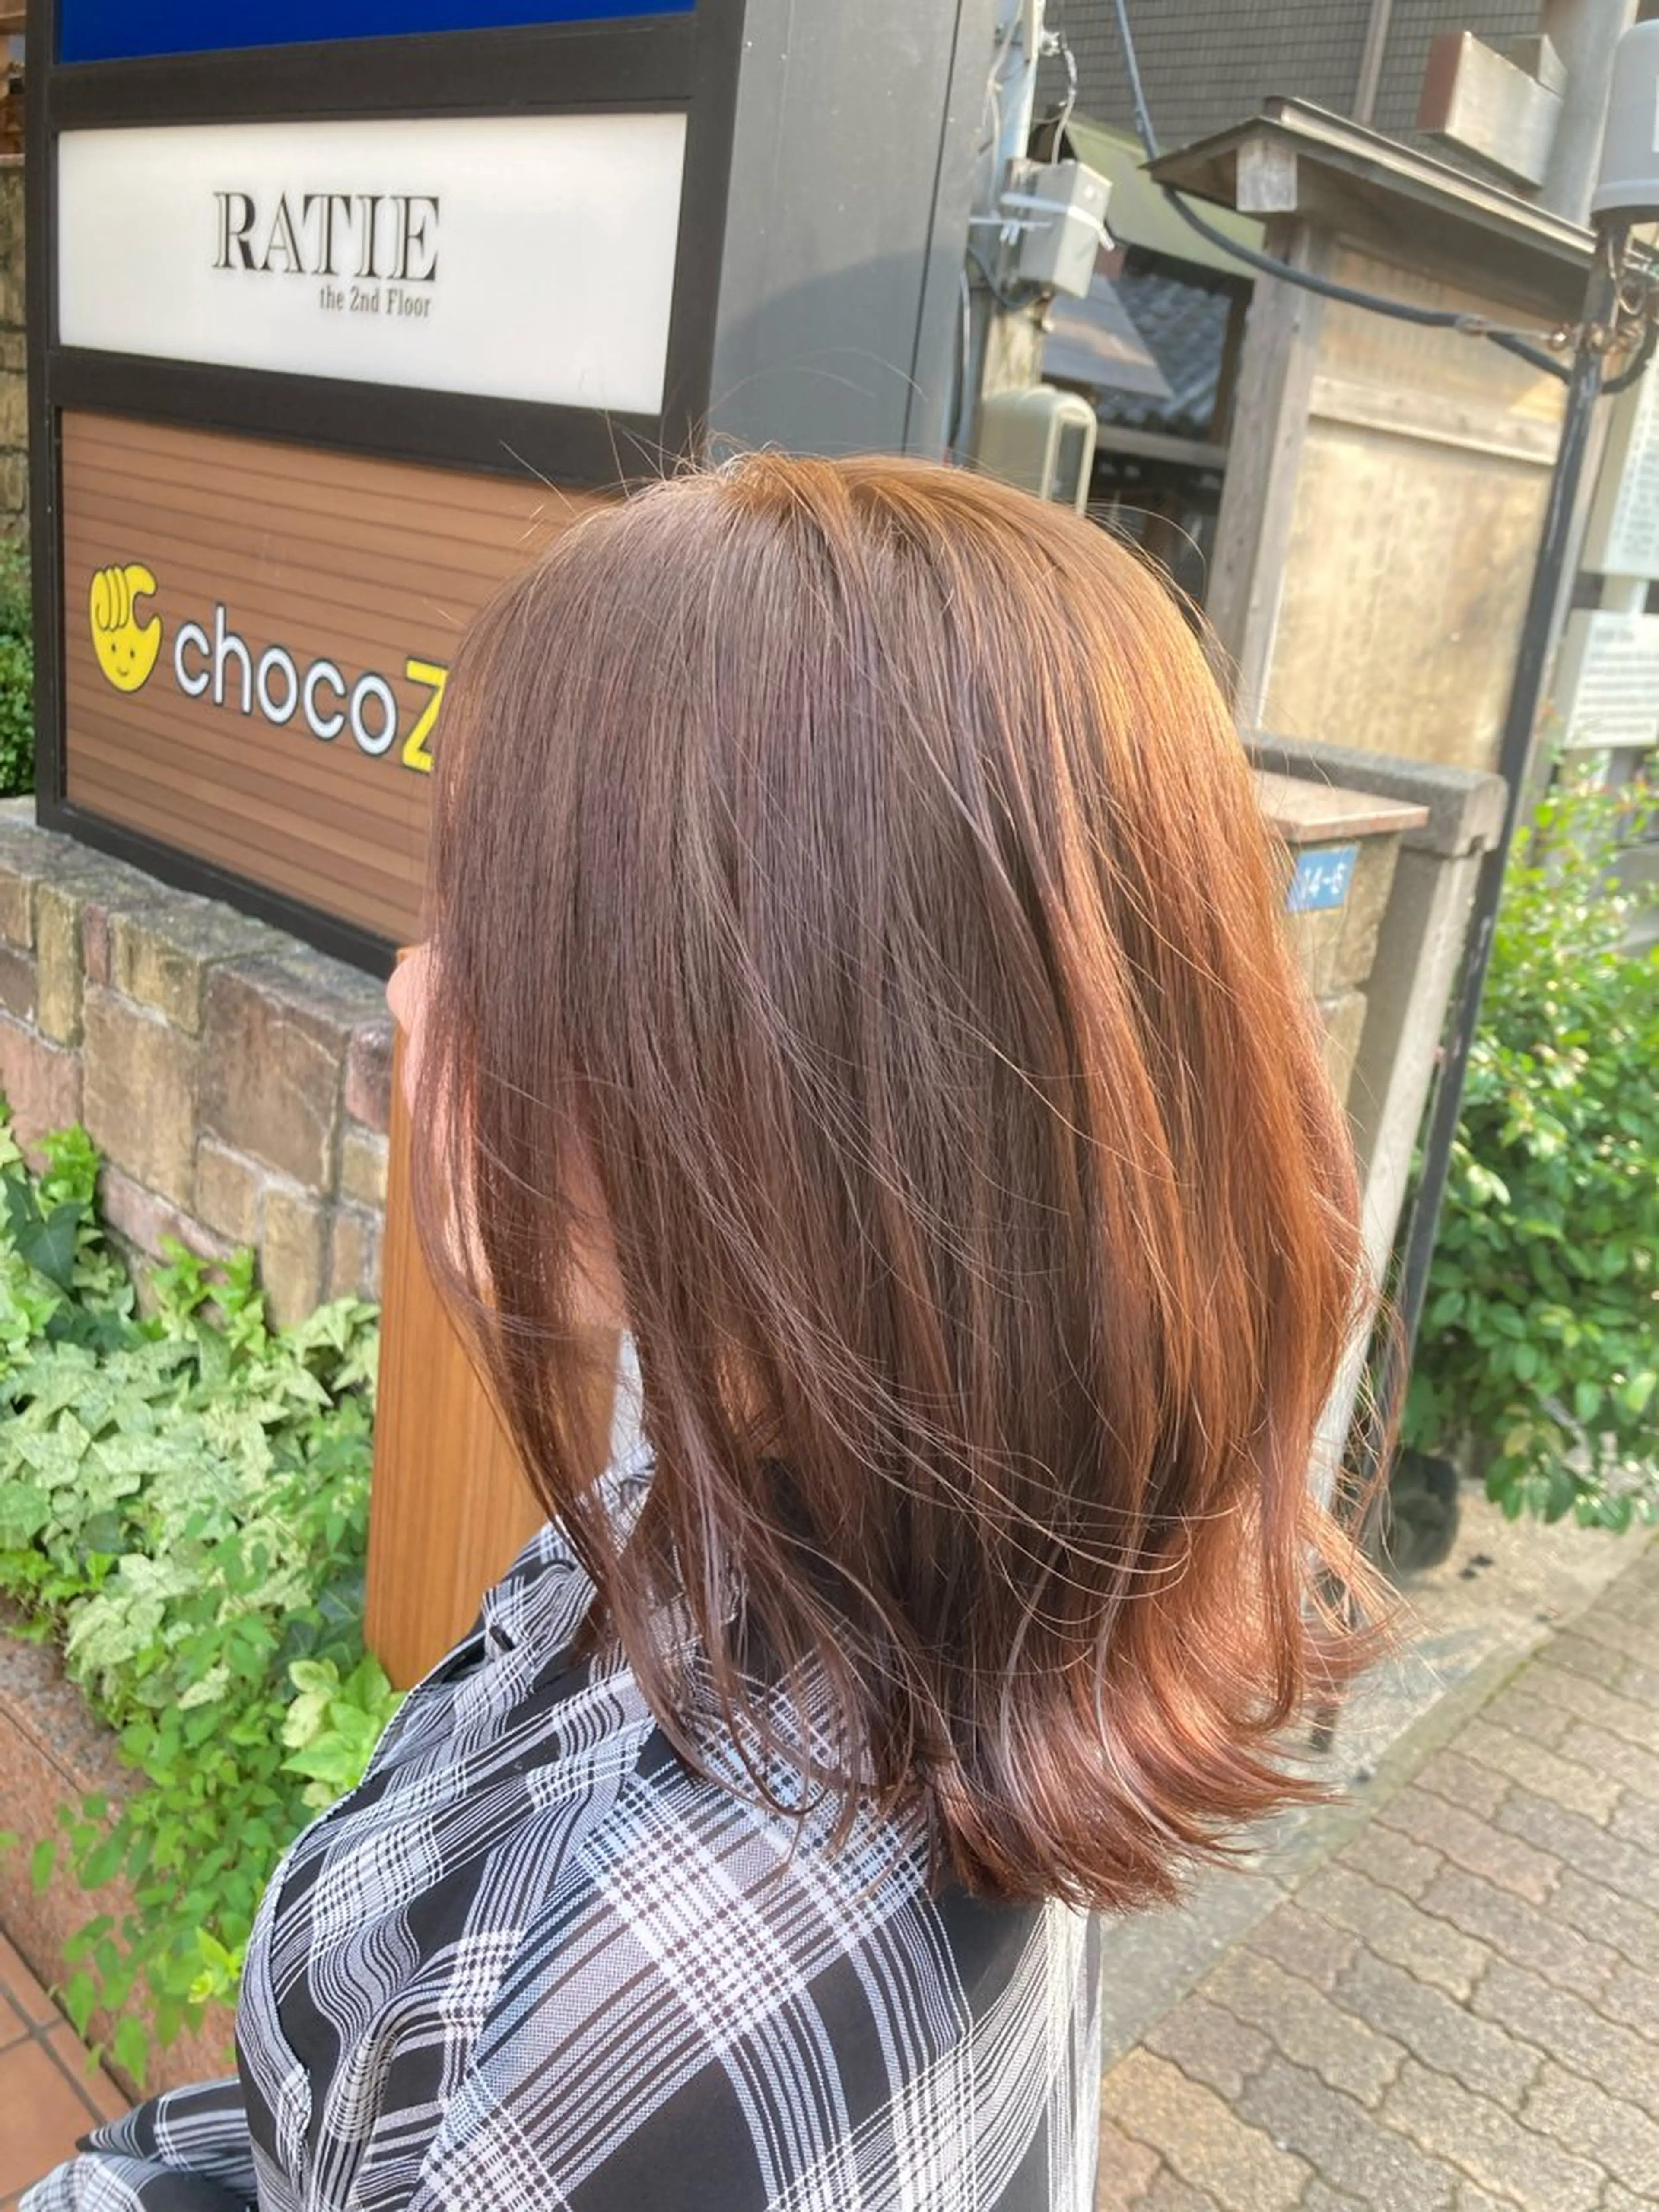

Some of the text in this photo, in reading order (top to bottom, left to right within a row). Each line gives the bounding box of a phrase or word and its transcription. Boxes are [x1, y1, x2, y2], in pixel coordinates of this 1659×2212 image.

[212, 191, 439, 282] RATIE
[319, 284, 432, 318] the 2nd Floor
